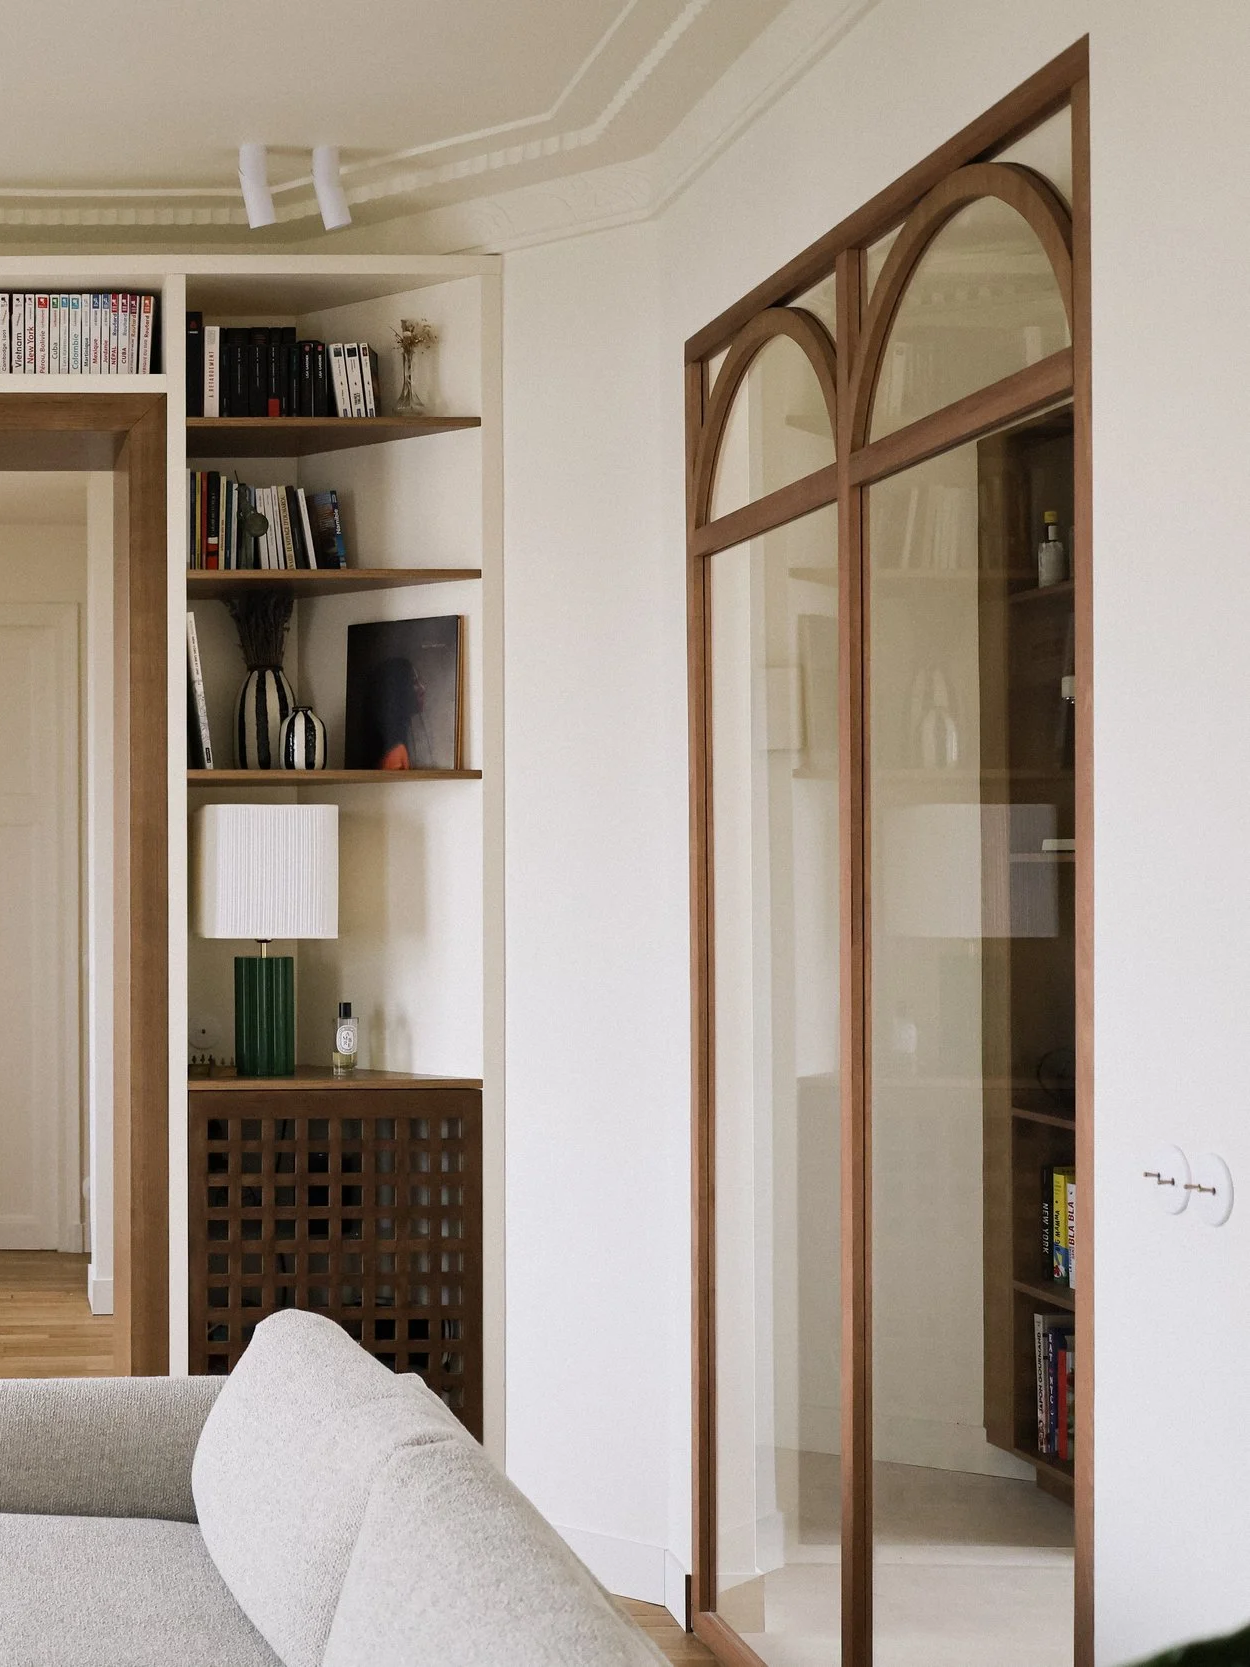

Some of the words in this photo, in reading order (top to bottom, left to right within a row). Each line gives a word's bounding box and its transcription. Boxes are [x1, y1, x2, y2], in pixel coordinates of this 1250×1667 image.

[71, 333, 79, 370] Colombie
[333, 509, 341, 535] Namibie
[1067, 1202, 1075, 1222] BLA
[1067, 1226, 1075, 1246] BLA
